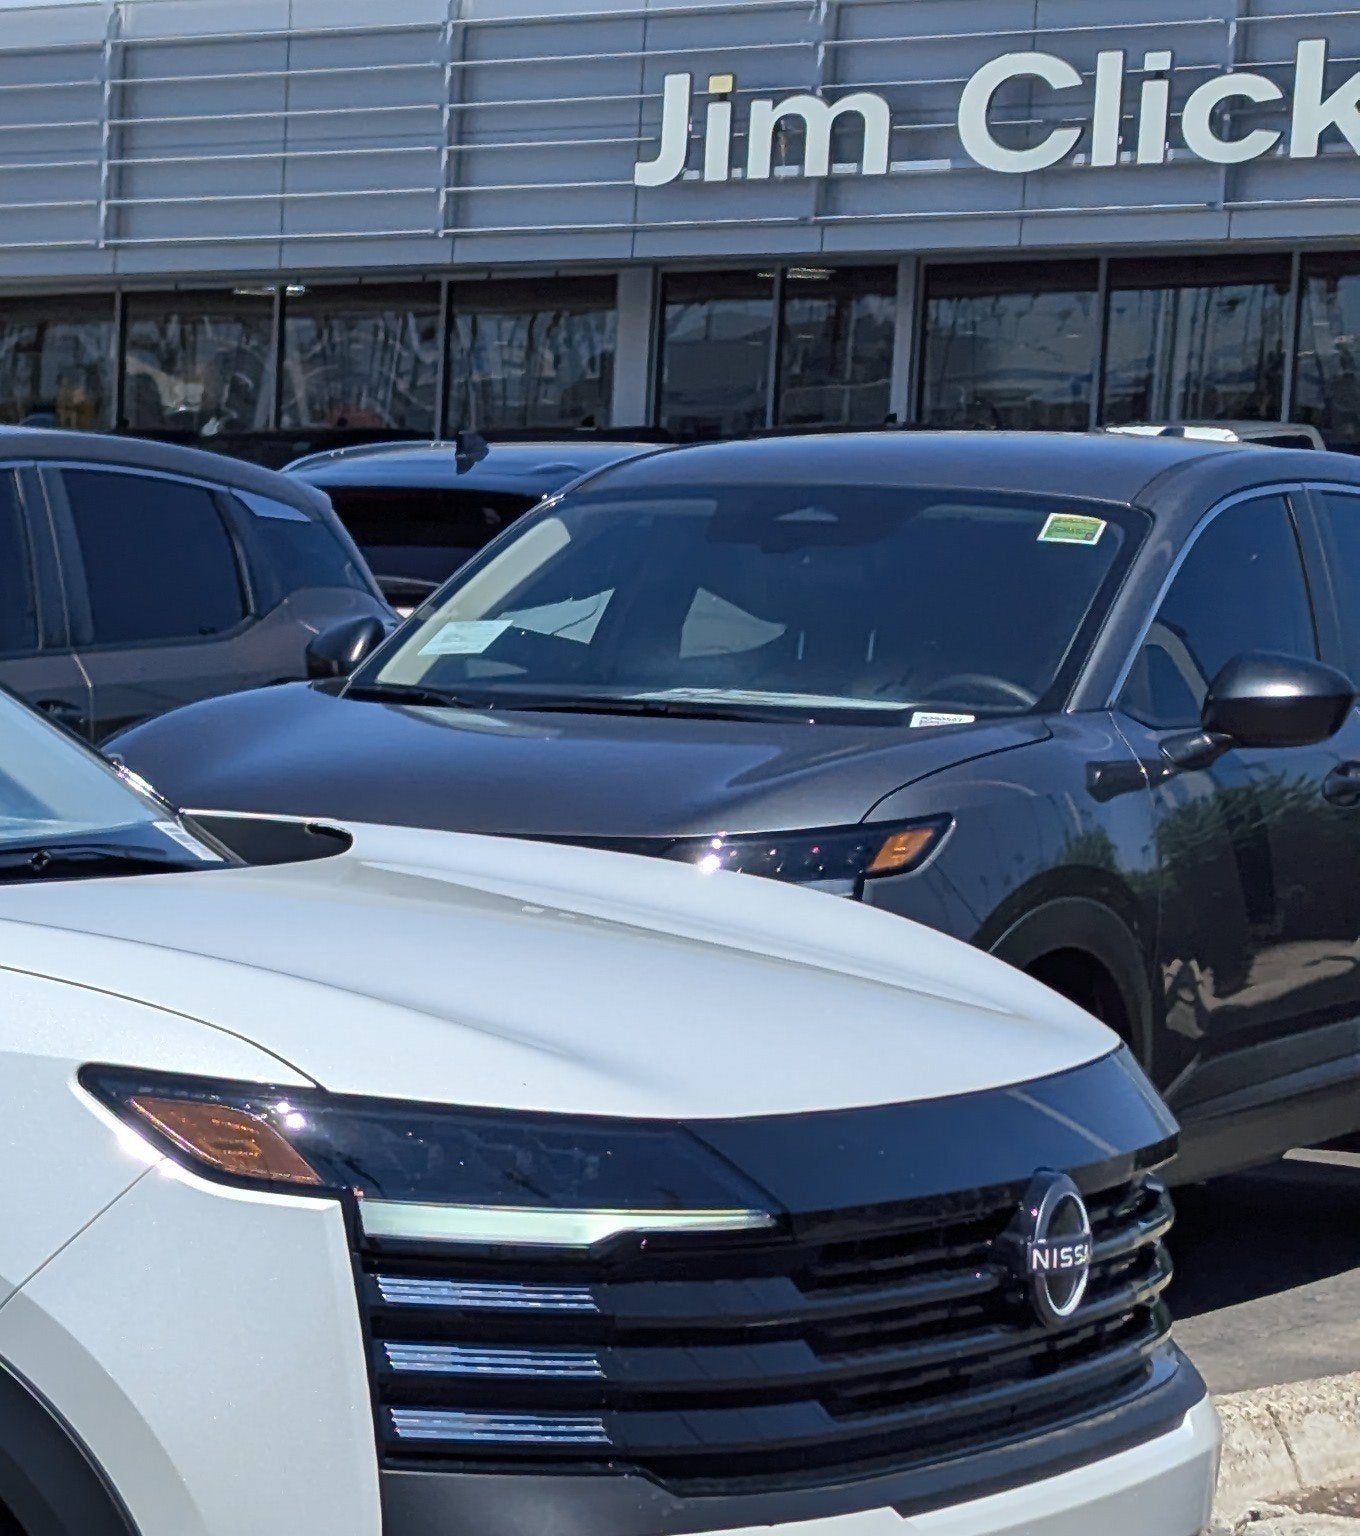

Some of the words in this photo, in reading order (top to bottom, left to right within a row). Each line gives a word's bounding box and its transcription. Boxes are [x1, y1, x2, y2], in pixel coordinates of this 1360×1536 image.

[634, 73, 890, 187] Jim
[958, 38, 1360, 174] Click
[1032, 1244, 1088, 1270] NISS
